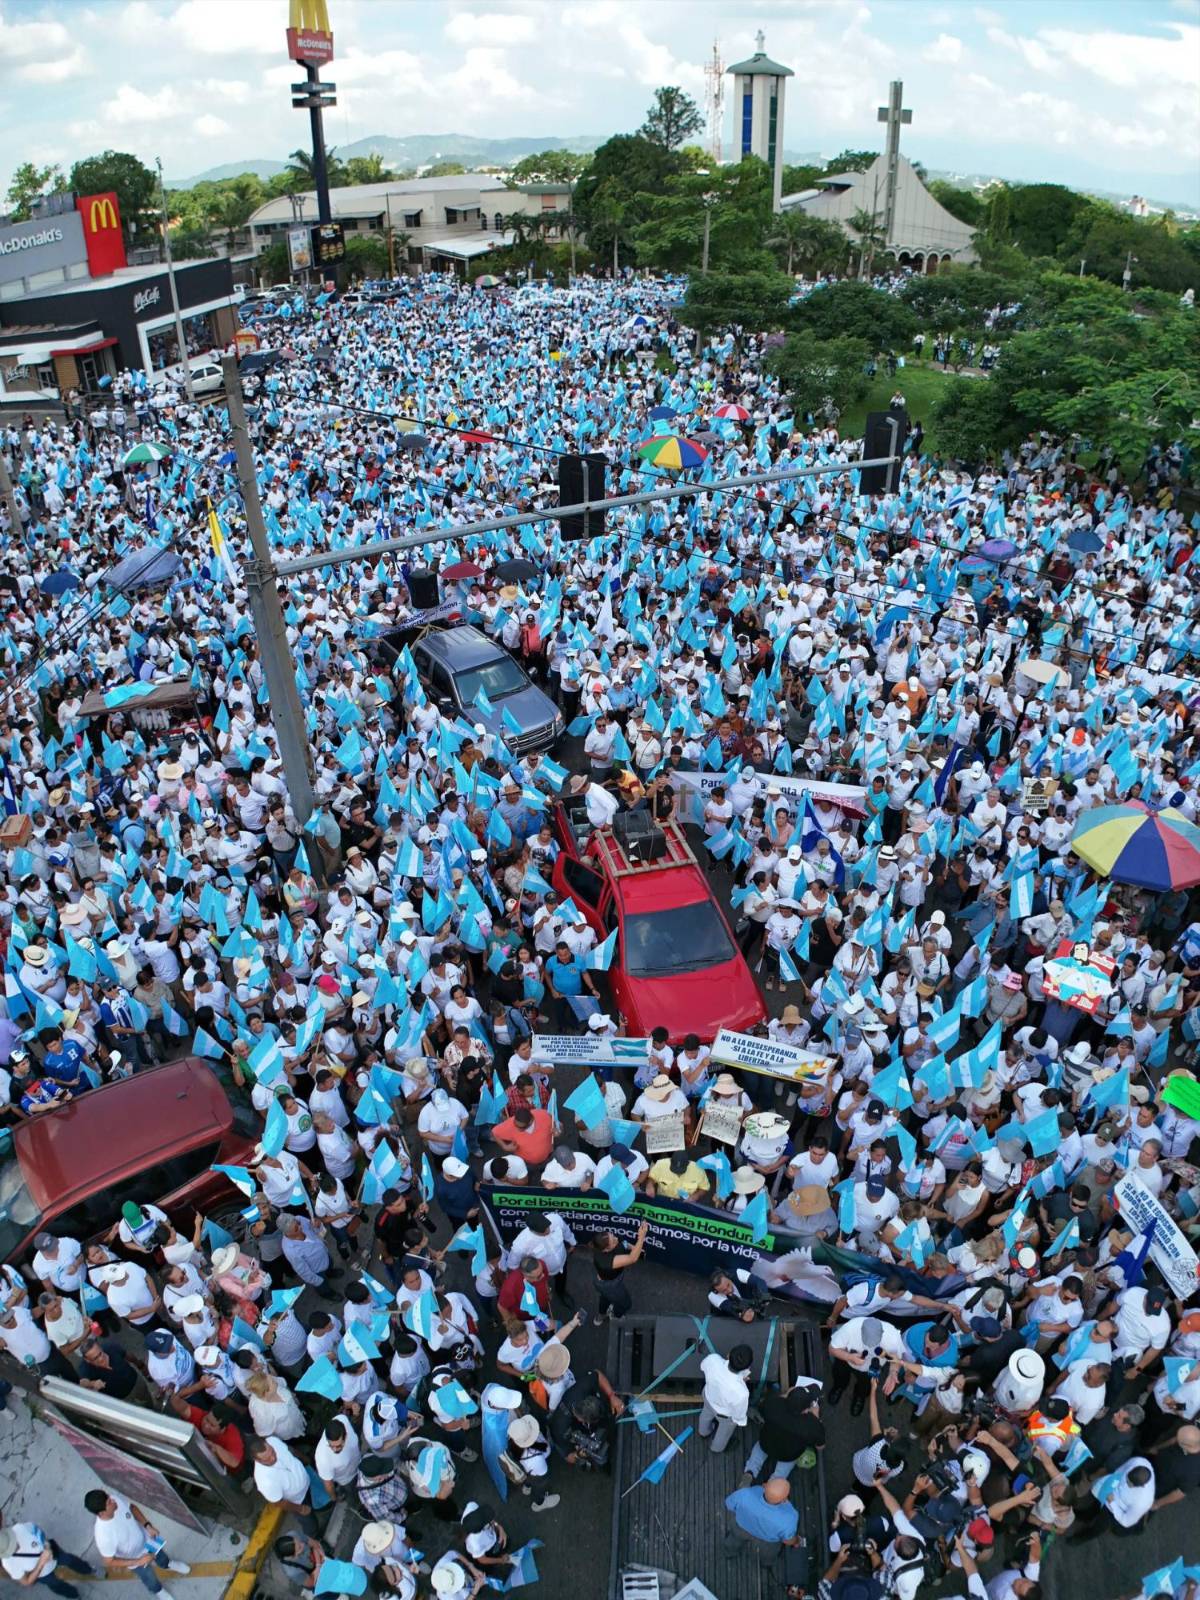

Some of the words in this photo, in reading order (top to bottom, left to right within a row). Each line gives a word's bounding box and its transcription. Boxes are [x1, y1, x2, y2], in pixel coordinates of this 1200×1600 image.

[720, 1034, 730, 1043] NO
[731, 1036, 738, 1044] A
[738, 1037, 747, 1046] LA
[747, 1048, 756, 1057] LA
[756, 1050, 764, 1058] FE
[769, 1054, 776, 1062] A
[776, 1055, 785, 1064] LA
[1138, 1190, 1149, 1202] NO
[1145, 1199, 1156, 1211] AL
[499, 1196, 524, 1206] Por
[524, 1197, 540, 1206] el
[539, 1198, 571, 1209] bien
[571, 1200, 591, 1210] de
[591, 1202, 646, 1216] nura
[647, 1209, 695, 1229] amada
[696, 1220, 769, 1251] Hondurs,
[500, 1218, 514, 1229] la
[499, 1208, 530, 1217] com
[541, 1210, 609, 1222] cstianos
[610, 1213, 690, 1241] camnamos
[692, 1234, 718, 1249] por
[717, 1239, 730, 1253] la
[731, 1243, 760, 1261] vida
[572, 1220, 584, 1231] la
[585, 1224, 667, 1251] democrcia.
[1168, 1242, 1181, 1259] CON
